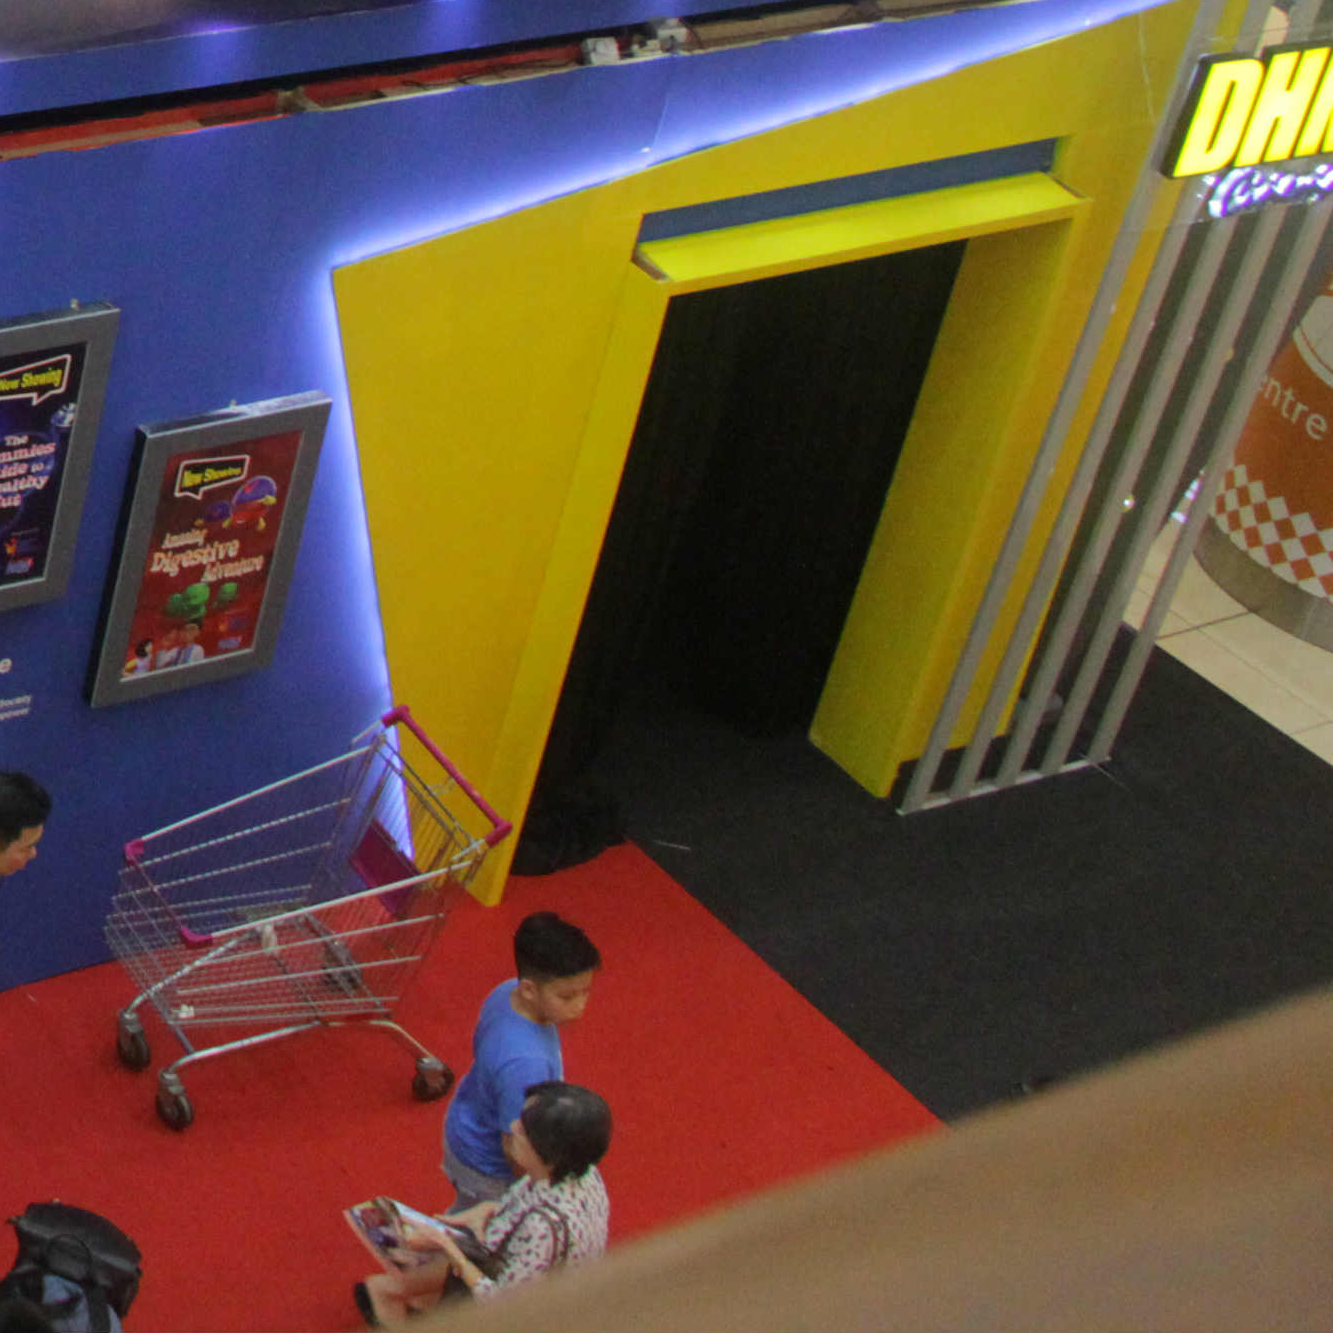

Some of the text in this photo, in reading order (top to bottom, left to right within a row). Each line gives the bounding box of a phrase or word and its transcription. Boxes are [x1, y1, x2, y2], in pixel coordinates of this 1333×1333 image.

[1261, 377, 1328, 441] ntre
[5, 435, 29, 446] The
[150, 539, 240, 577] Digestive
